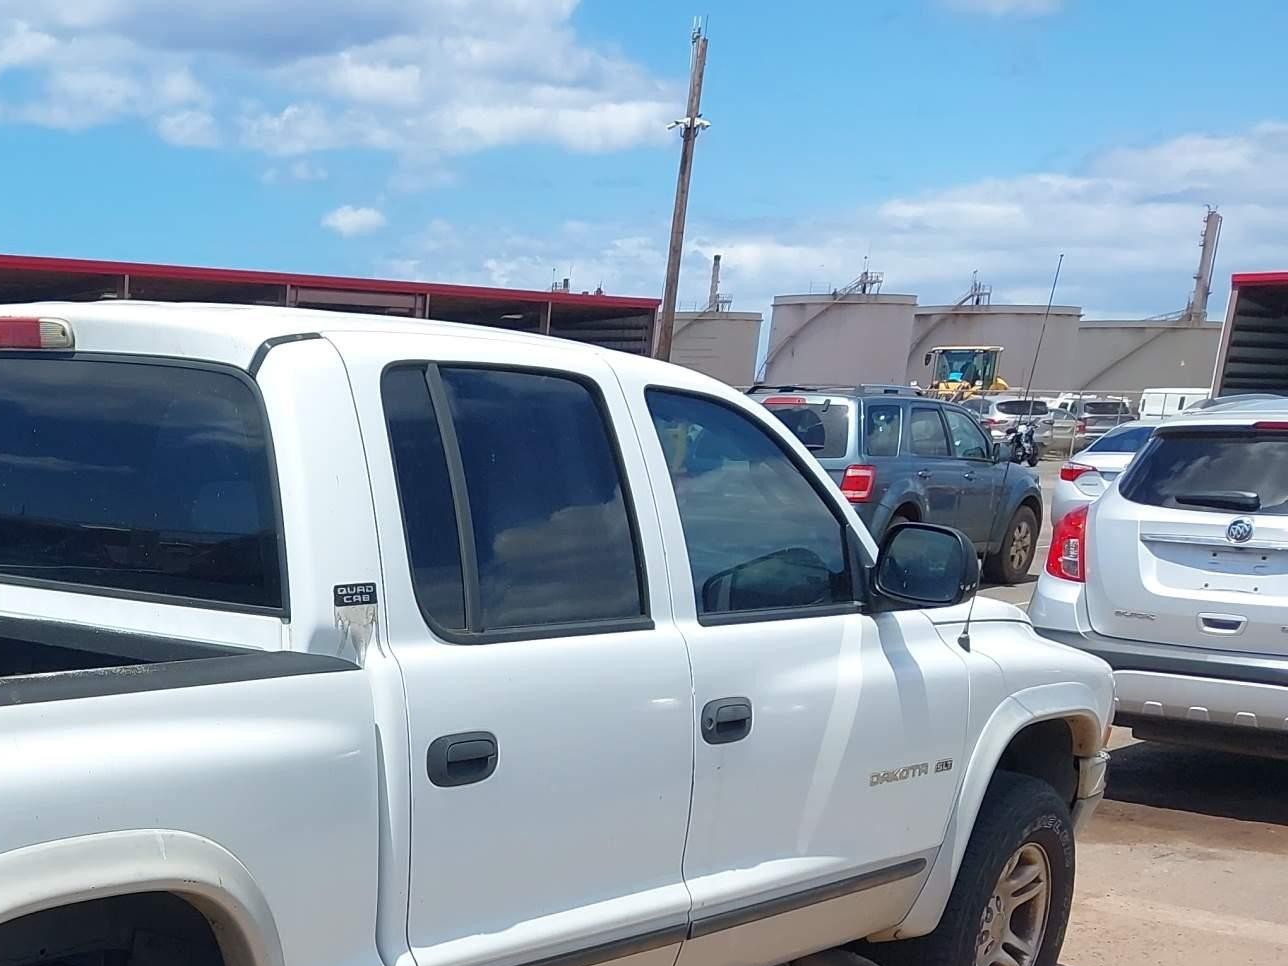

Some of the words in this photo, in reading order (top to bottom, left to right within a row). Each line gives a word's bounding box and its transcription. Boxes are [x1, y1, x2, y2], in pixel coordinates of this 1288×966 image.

[337, 585, 374, 595] QUAD
[343, 594, 370, 603] CAB
[869, 762, 929, 787] DAKOTA
